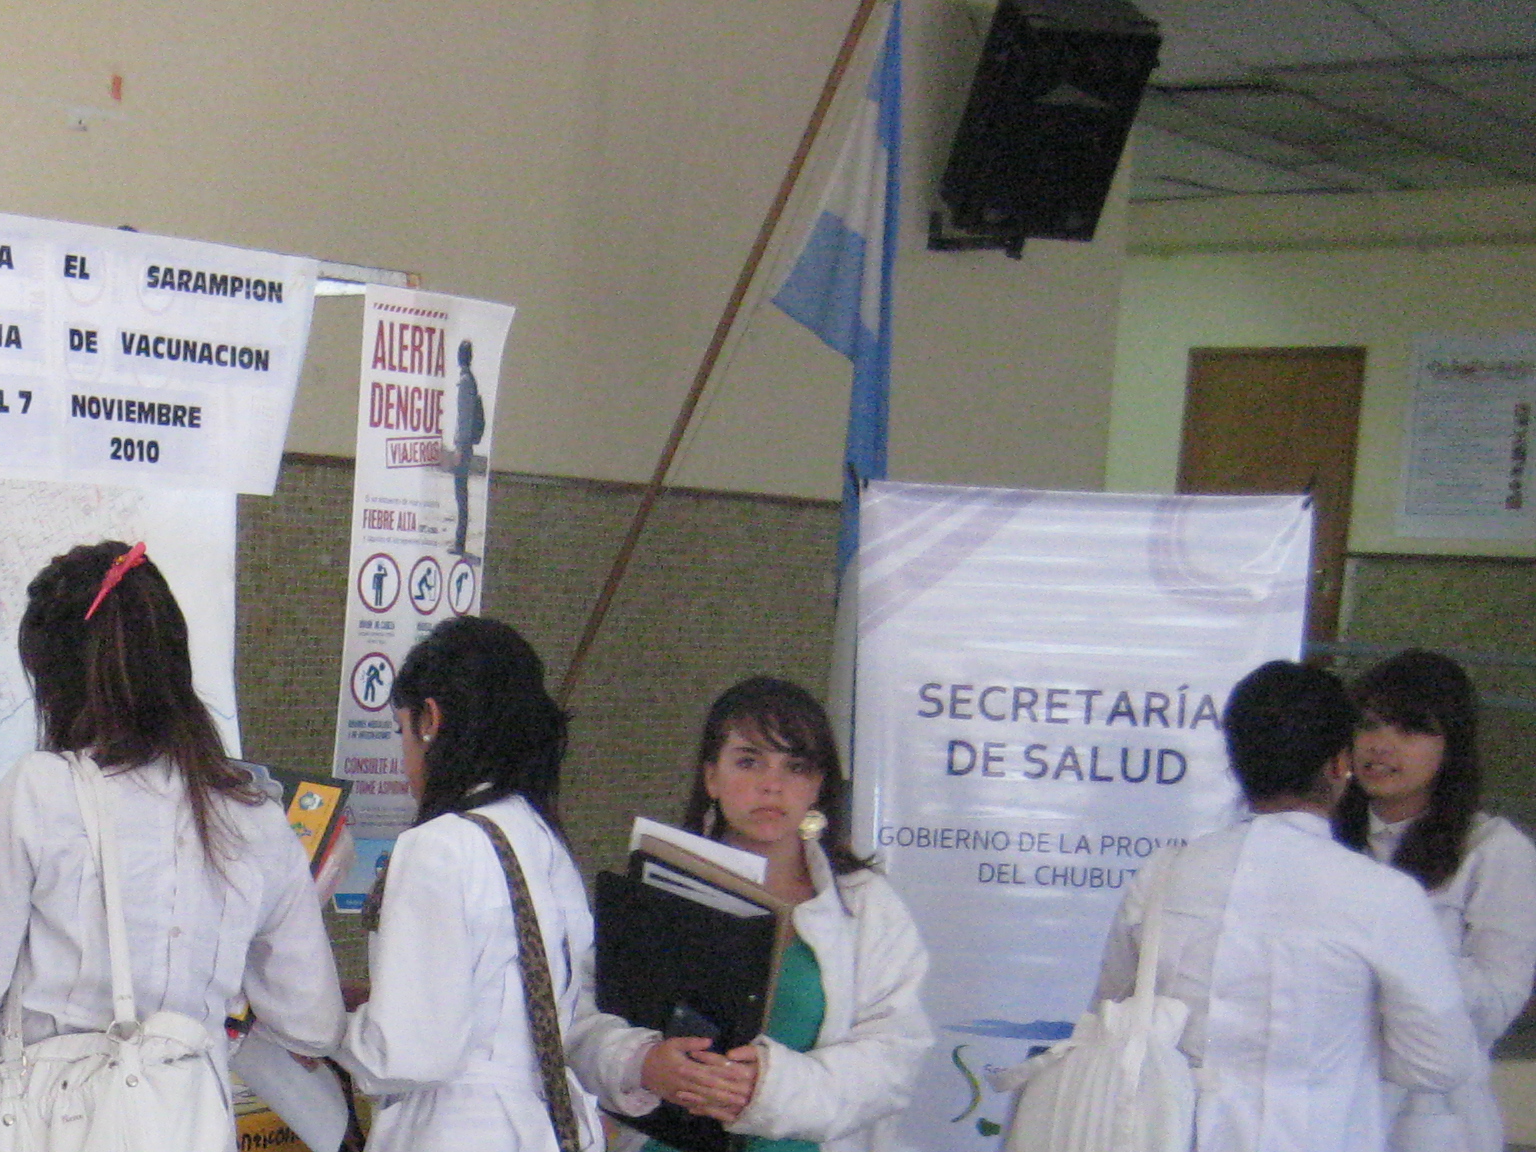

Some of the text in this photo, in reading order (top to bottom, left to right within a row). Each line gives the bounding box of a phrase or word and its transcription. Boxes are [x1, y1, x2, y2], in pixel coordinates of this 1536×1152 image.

[64, 254, 90, 282] EL
[146, 264, 284, 305] SARAMPION
[68, 327, 99, 355] DE
[120, 331, 271, 373] VACUNACION
[370, 319, 446, 378] ALERTA
[19, 390, 33, 417] 7
[70, 393, 203, 430] NOVIEMBRE
[369, 381, 445, 435] DENGUE
[110, 437, 161, 465] 2010
[390, 440, 442, 465] VIAJEROS
[362, 508, 417, 532] FIEBRE ALTA
[916, 681, 1223, 732] SECRETARÍA
[945, 739, 1188, 786] DE SALUD
[877, 825, 1011, 853] GOBIERNO
[1018, 831, 1052, 855] DE
[1058, 833, 1092, 855] LA
[977, 861, 1026, 887] DEL
